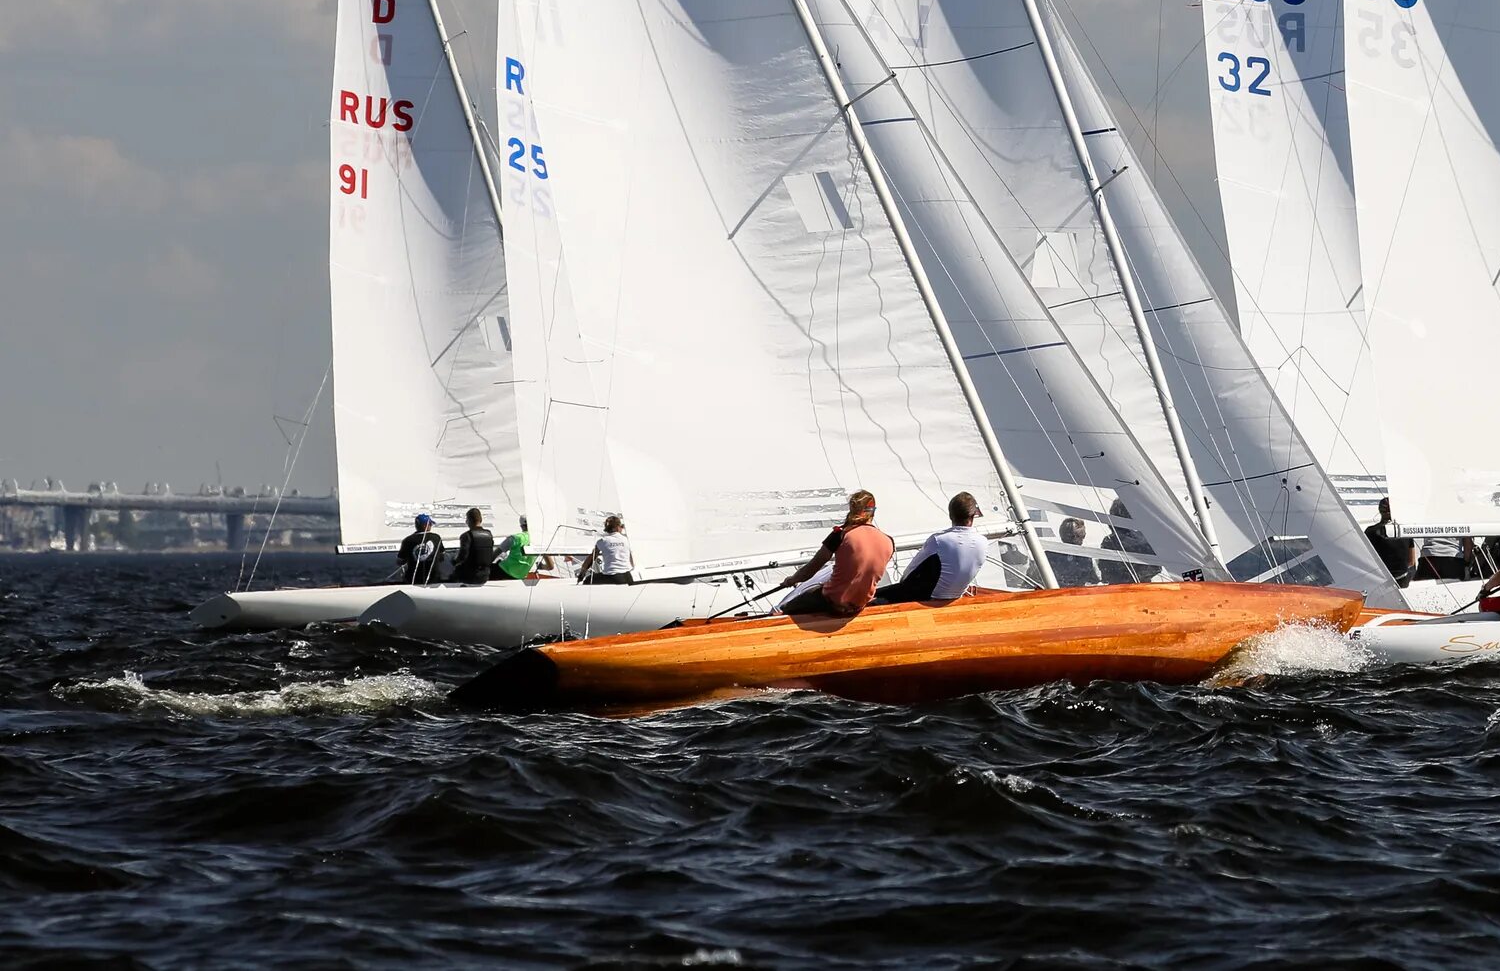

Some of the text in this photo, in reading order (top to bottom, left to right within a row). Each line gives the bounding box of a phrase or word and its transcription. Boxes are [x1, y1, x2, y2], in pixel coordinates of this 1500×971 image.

[1217, 51, 1272, 97] 32
[340, 90, 414, 132] RUS
[508, 137, 548, 180] 25
[339, 163, 368, 199] 91
